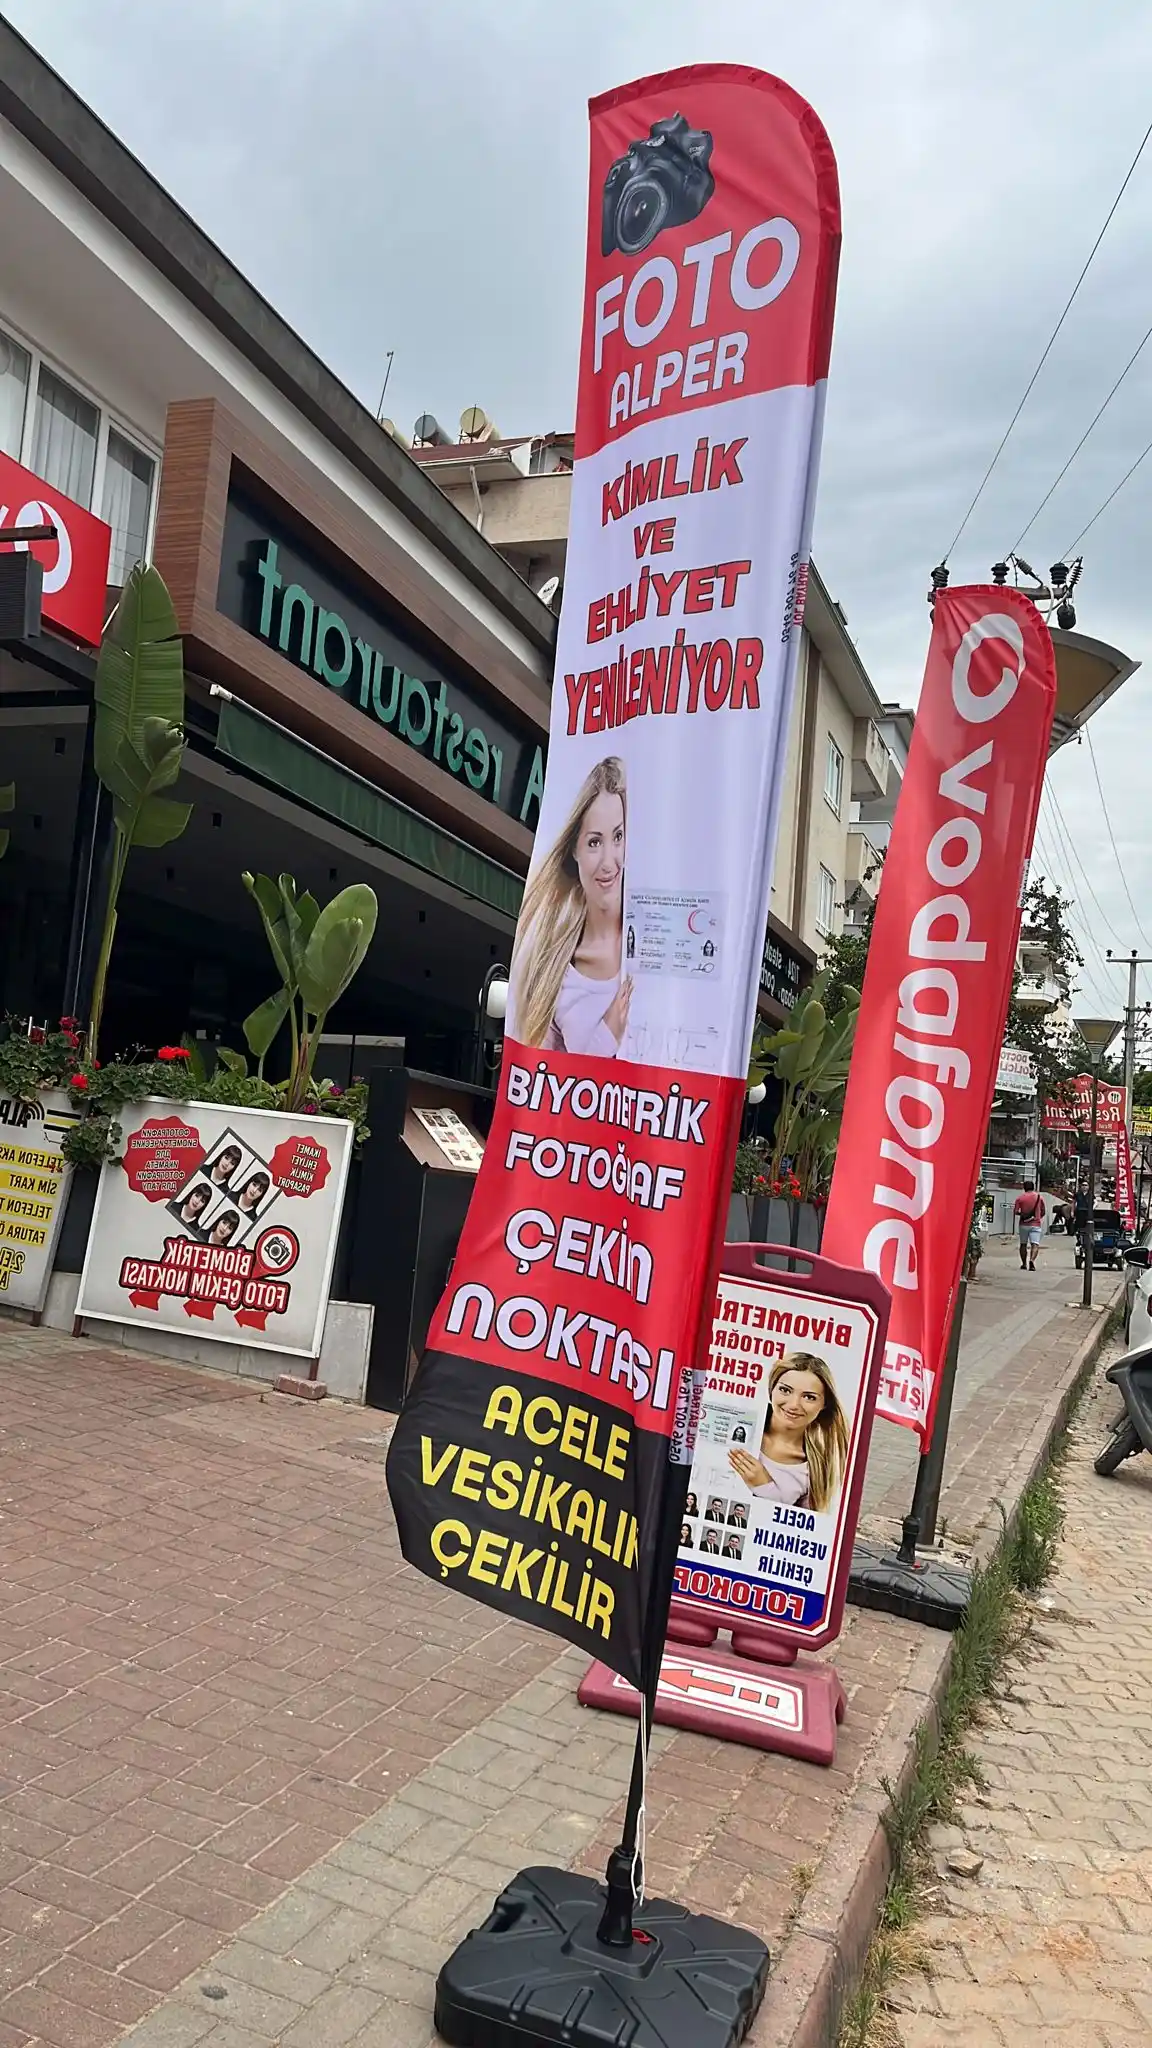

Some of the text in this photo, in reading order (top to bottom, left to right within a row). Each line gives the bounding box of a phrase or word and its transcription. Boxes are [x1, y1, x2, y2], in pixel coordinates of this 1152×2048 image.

[594, 216, 800, 375] FOTO
[608, 331, 749, 429] ALPER
[601, 437, 749, 527] KİMLİK
[633, 517, 677, 559] VE
[586, 560, 752, 645] EHLİYET
[564, 628, 764, 736] YENİLENİYOR
[862, 739, 993, 1291] vodafone
[506, 1061, 709, 1145] BİYOMETRİK
[504, 1131, 685, 1211] FOTOĞAF
[445, 1282, 676, 1411] NOKTASI
[483, 1385, 631, 1481] ACELE
[430, 1518, 616, 1640] ÇEKİLİR
